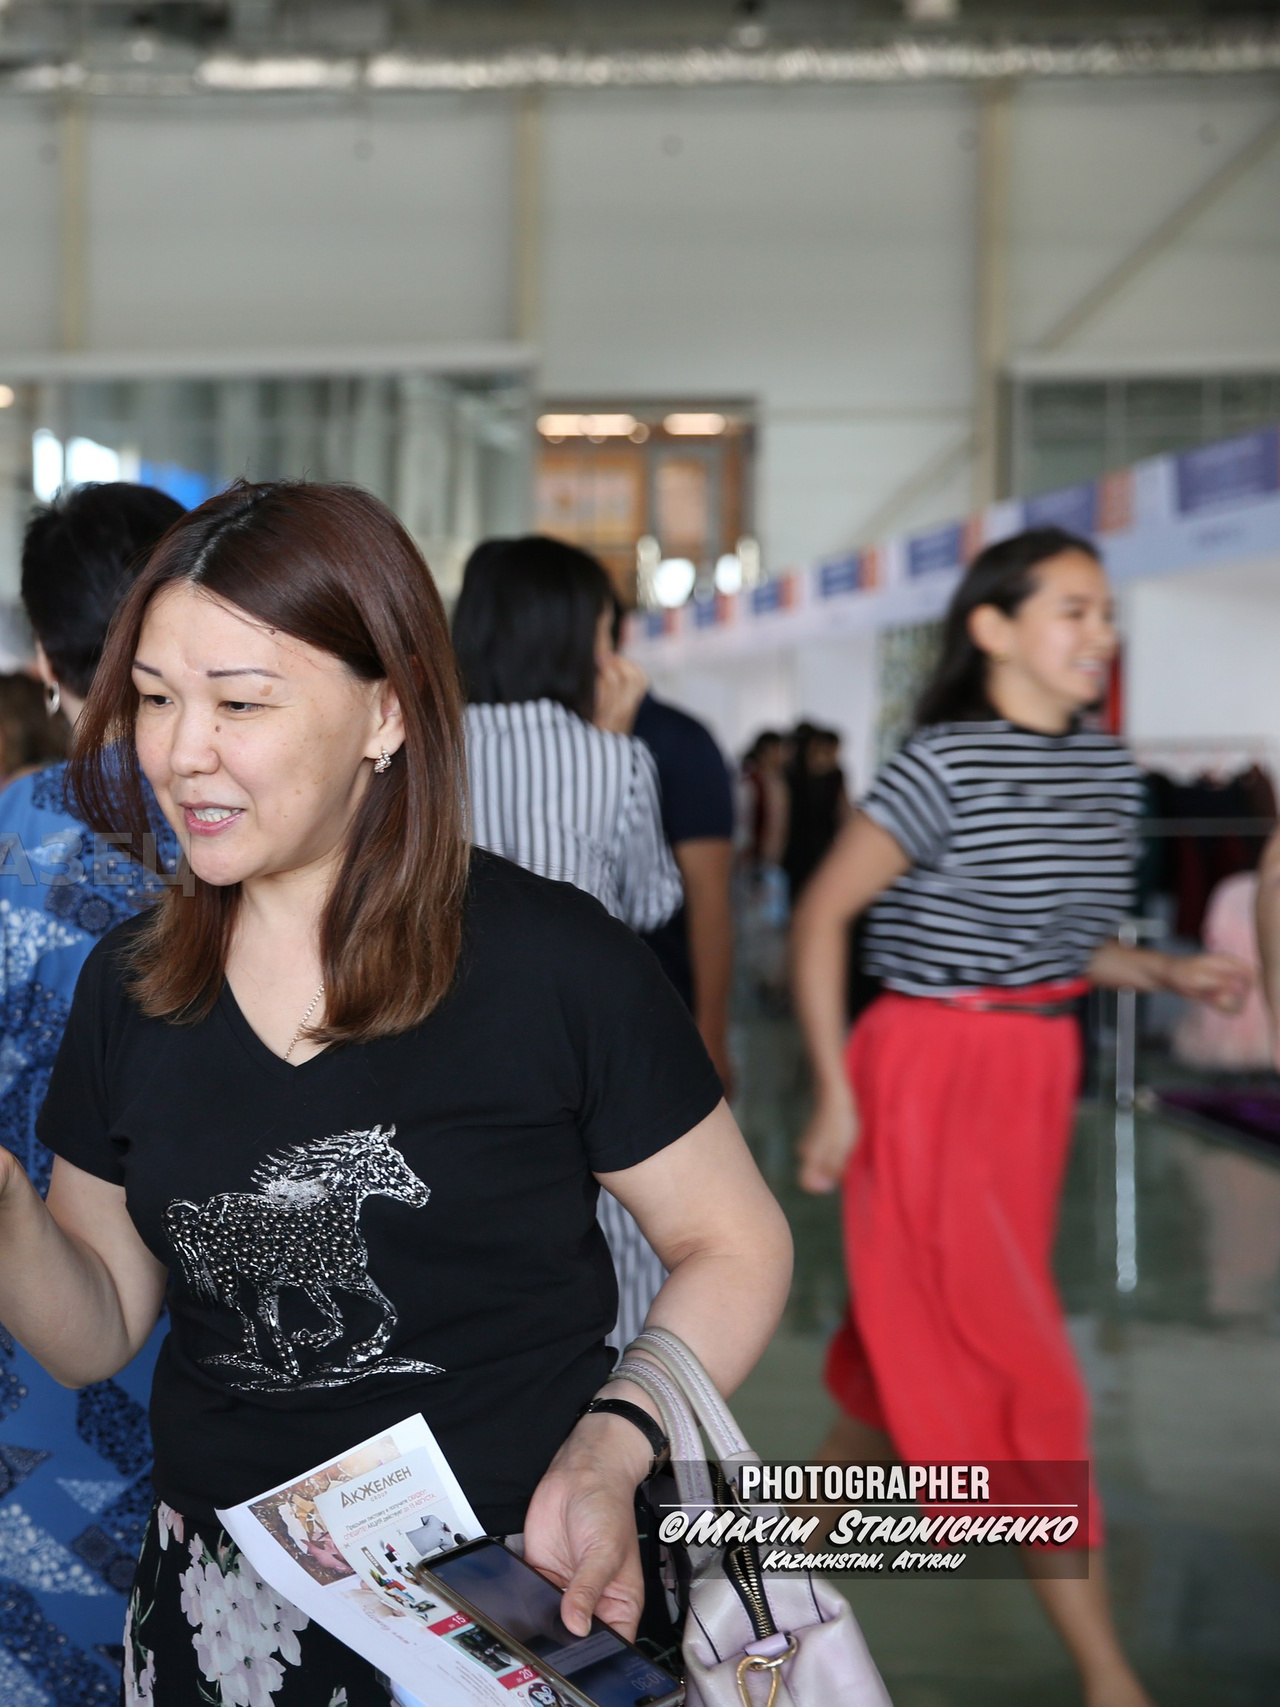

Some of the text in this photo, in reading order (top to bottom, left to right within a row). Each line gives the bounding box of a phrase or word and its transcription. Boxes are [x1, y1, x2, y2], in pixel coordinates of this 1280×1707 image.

[371, 1491, 388, 1502] GROUP
[367, 1518, 383, 1530] АКЦИЯ
[631, 1671, 665, 1691] 10:30
